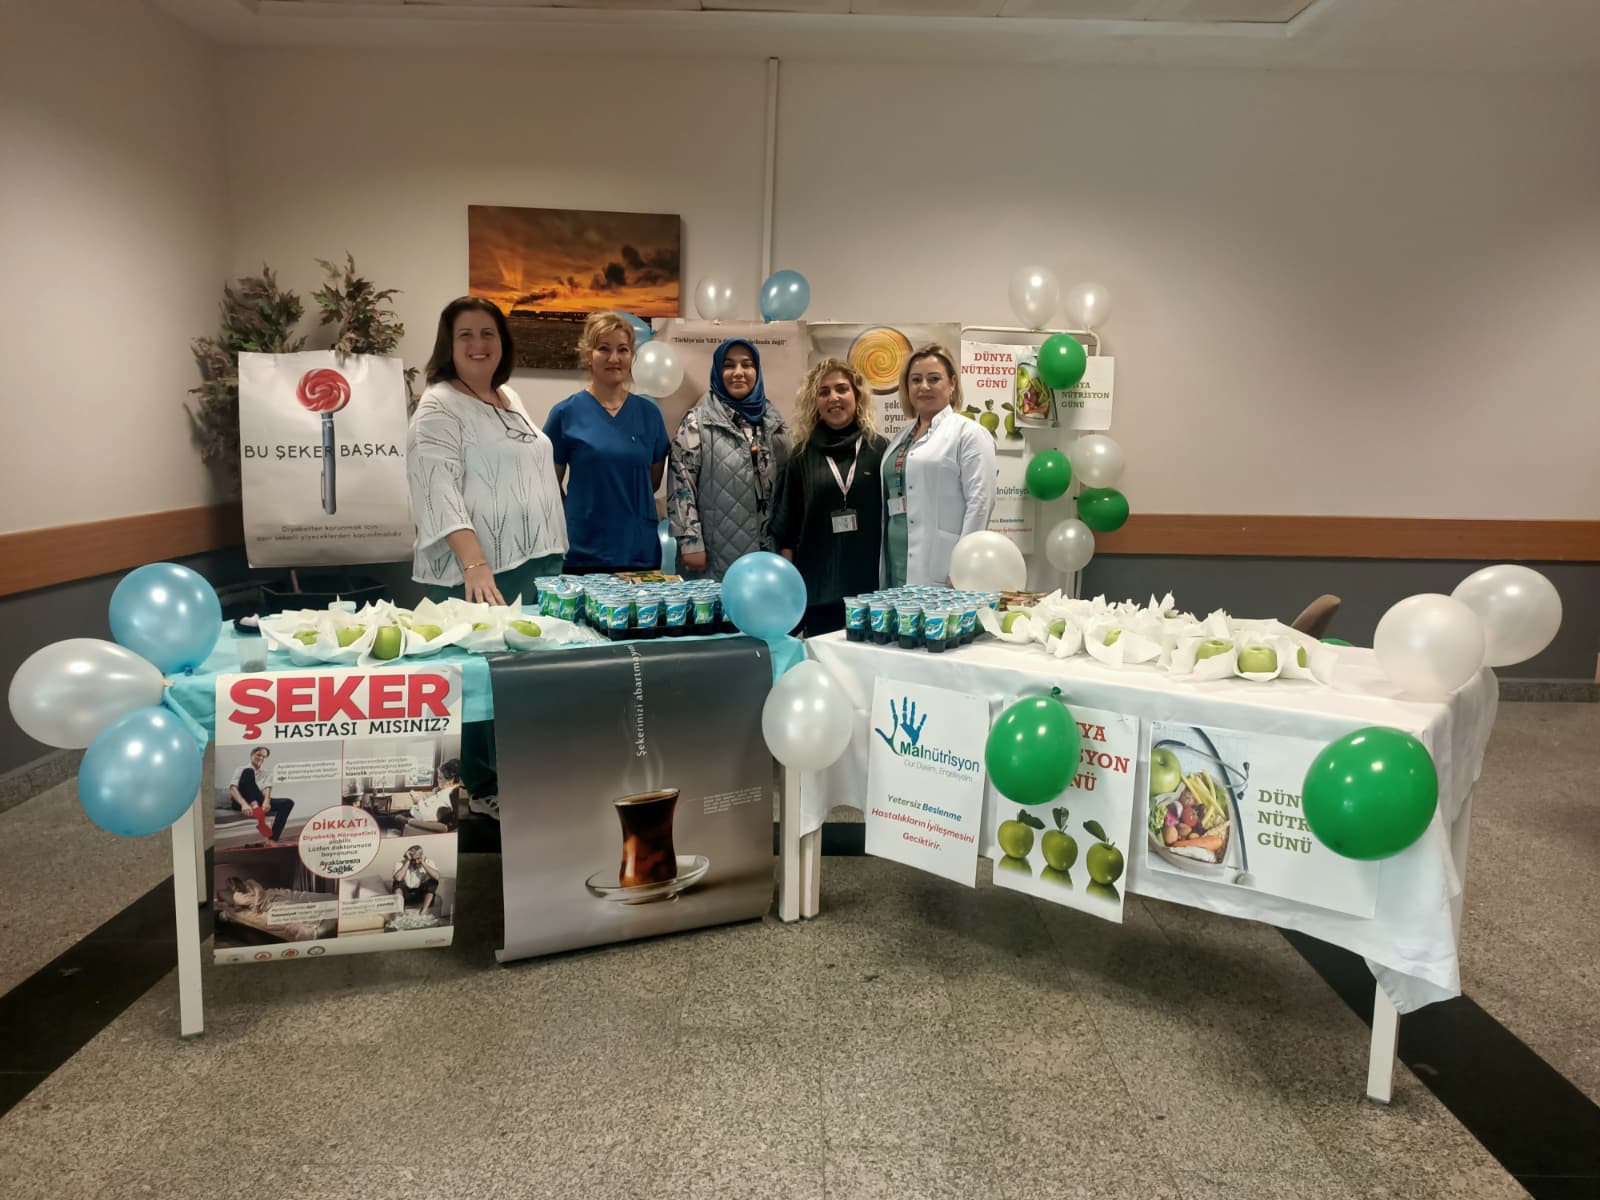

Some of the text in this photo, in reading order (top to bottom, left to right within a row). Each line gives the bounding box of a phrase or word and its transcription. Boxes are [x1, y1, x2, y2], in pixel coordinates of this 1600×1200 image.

[974, 351, 1013, 362] DÜNYA
[961, 364, 1016, 376] NÜTRİSYO
[976, 377, 1008, 388] GÜNÜ
[1061, 390, 1110, 399] NÜTRİSYON
[1061, 399, 1085, 408] GÜNÜ
[884, 425, 904, 434] olm
[244, 445, 268, 458] BU
[340, 443, 404, 458] BAŞKA.
[228, 673, 451, 740] ŞEKER
[274, 717, 450, 739] HASTASI MISINIZ?
[635, 704, 648, 757] Şekerinizi
[900, 740, 980, 772] Malnütrisyon
[1070, 771, 1097, 792] NÜ
[888, 794, 962, 822] Yetersiz Beslenme
[1257, 788, 1302, 808] DÜN
[312, 818, 368, 831] DİKKAT!
[872, 808, 975, 844] Hastalıkların İyileşmesini
[1256, 831, 1313, 854] GÜNÜ
